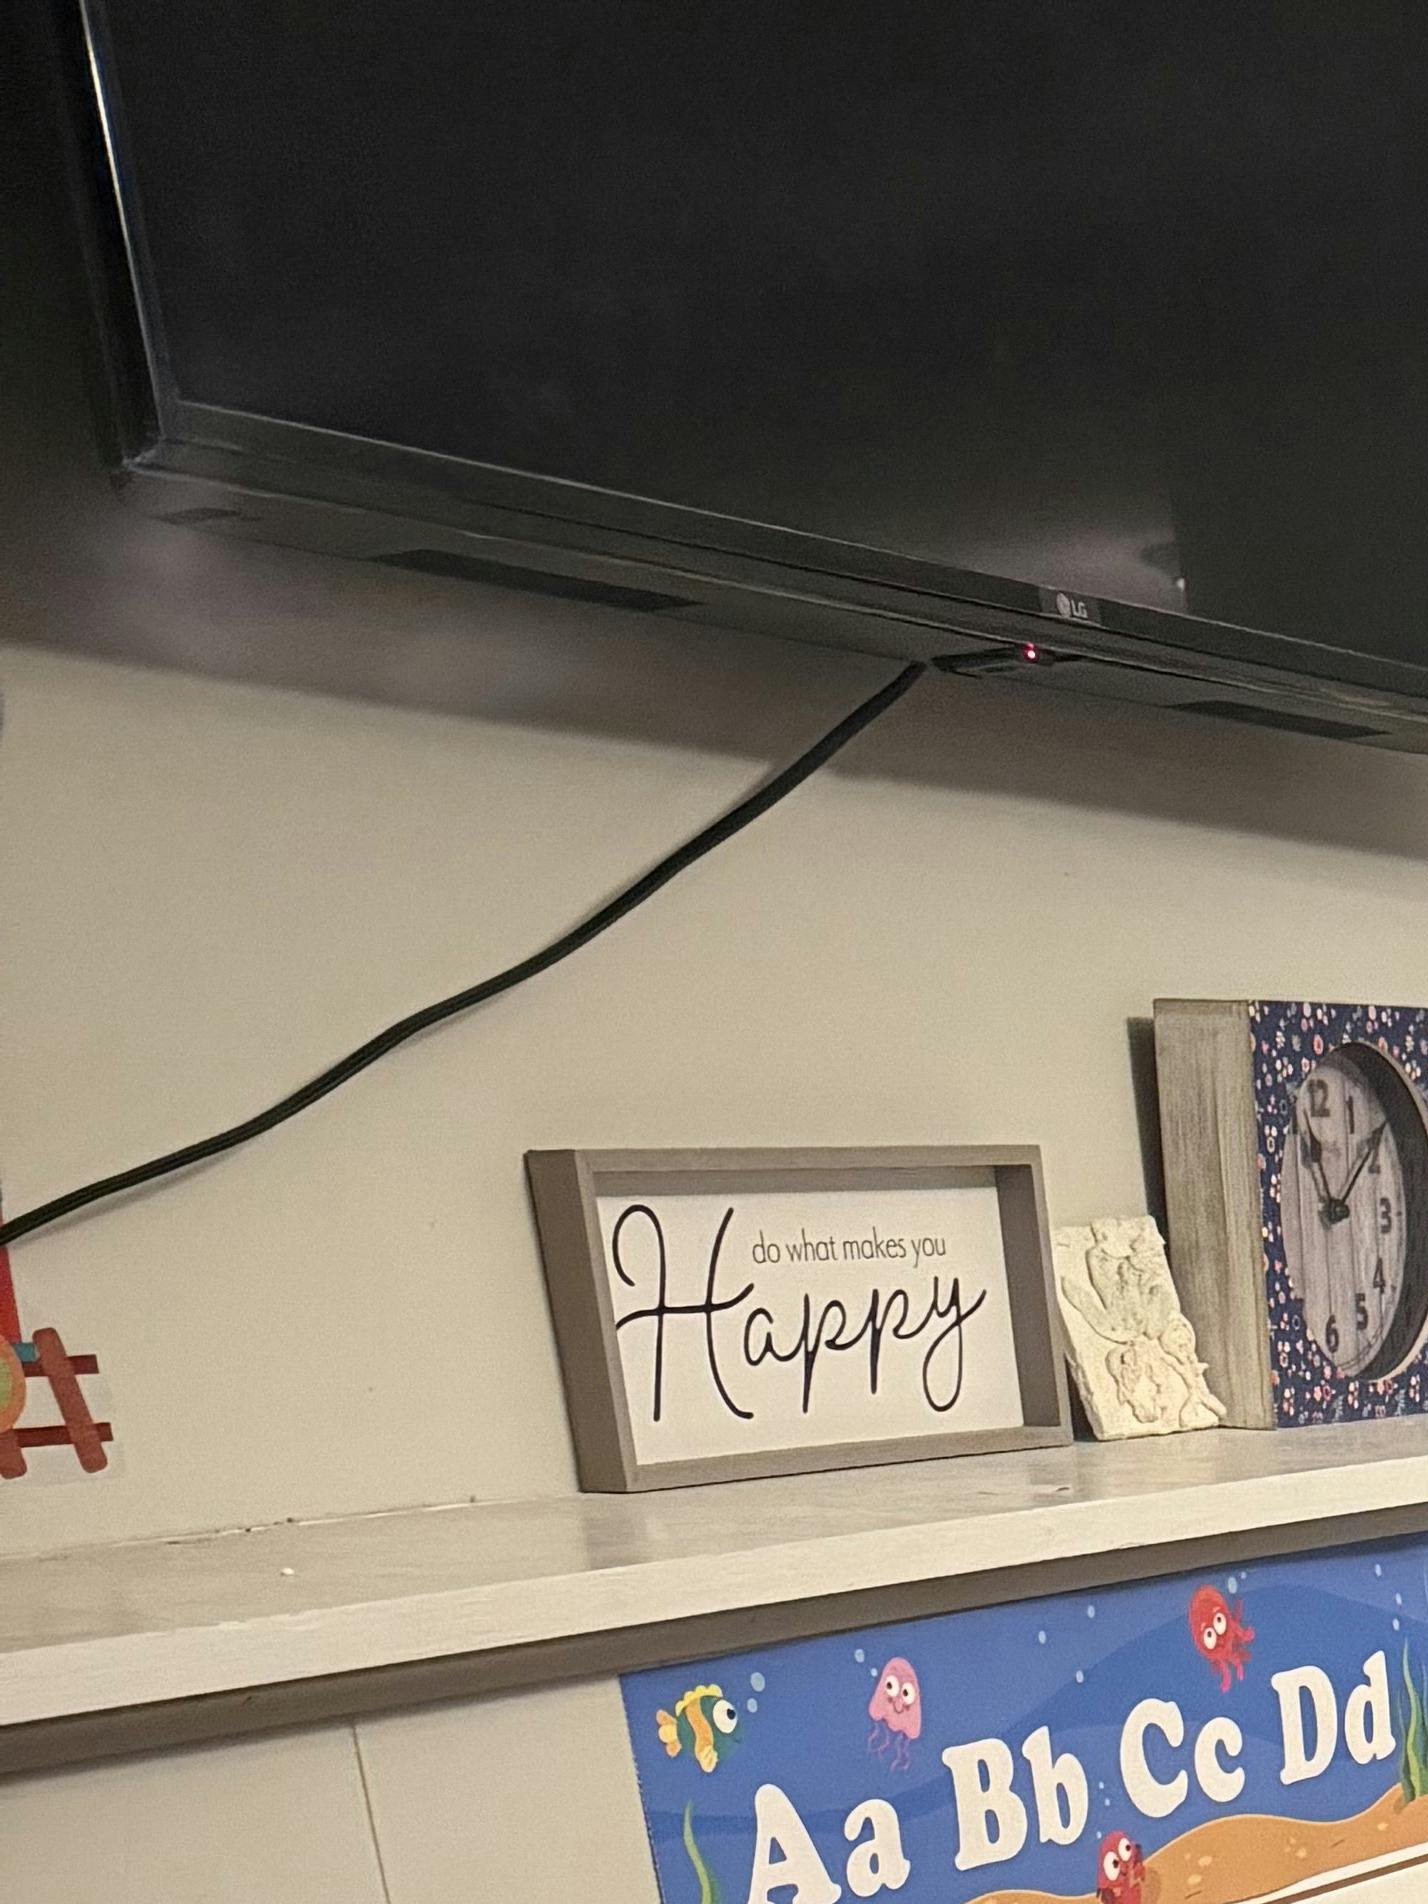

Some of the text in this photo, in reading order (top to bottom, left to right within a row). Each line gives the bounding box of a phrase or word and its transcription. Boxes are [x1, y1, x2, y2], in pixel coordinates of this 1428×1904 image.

[1070, 599, 1088, 618] LG
[1307, 1079, 1330, 1118] 12
[1380, 1198, 1392, 1234] 3
[752, 1226, 947, 1268] do what makes you
[1374, 1257, 1386, 1295] 4
[612, 1203, 988, 1422] Happy
[1356, 1293, 1369, 1331] 5
[1326, 1315, 1340, 1353] 6
[942, 1726, 1089, 1871] Bb
[1119, 1697, 1245, 1819] Cc
[1271, 1650, 1396, 1785] Dd
